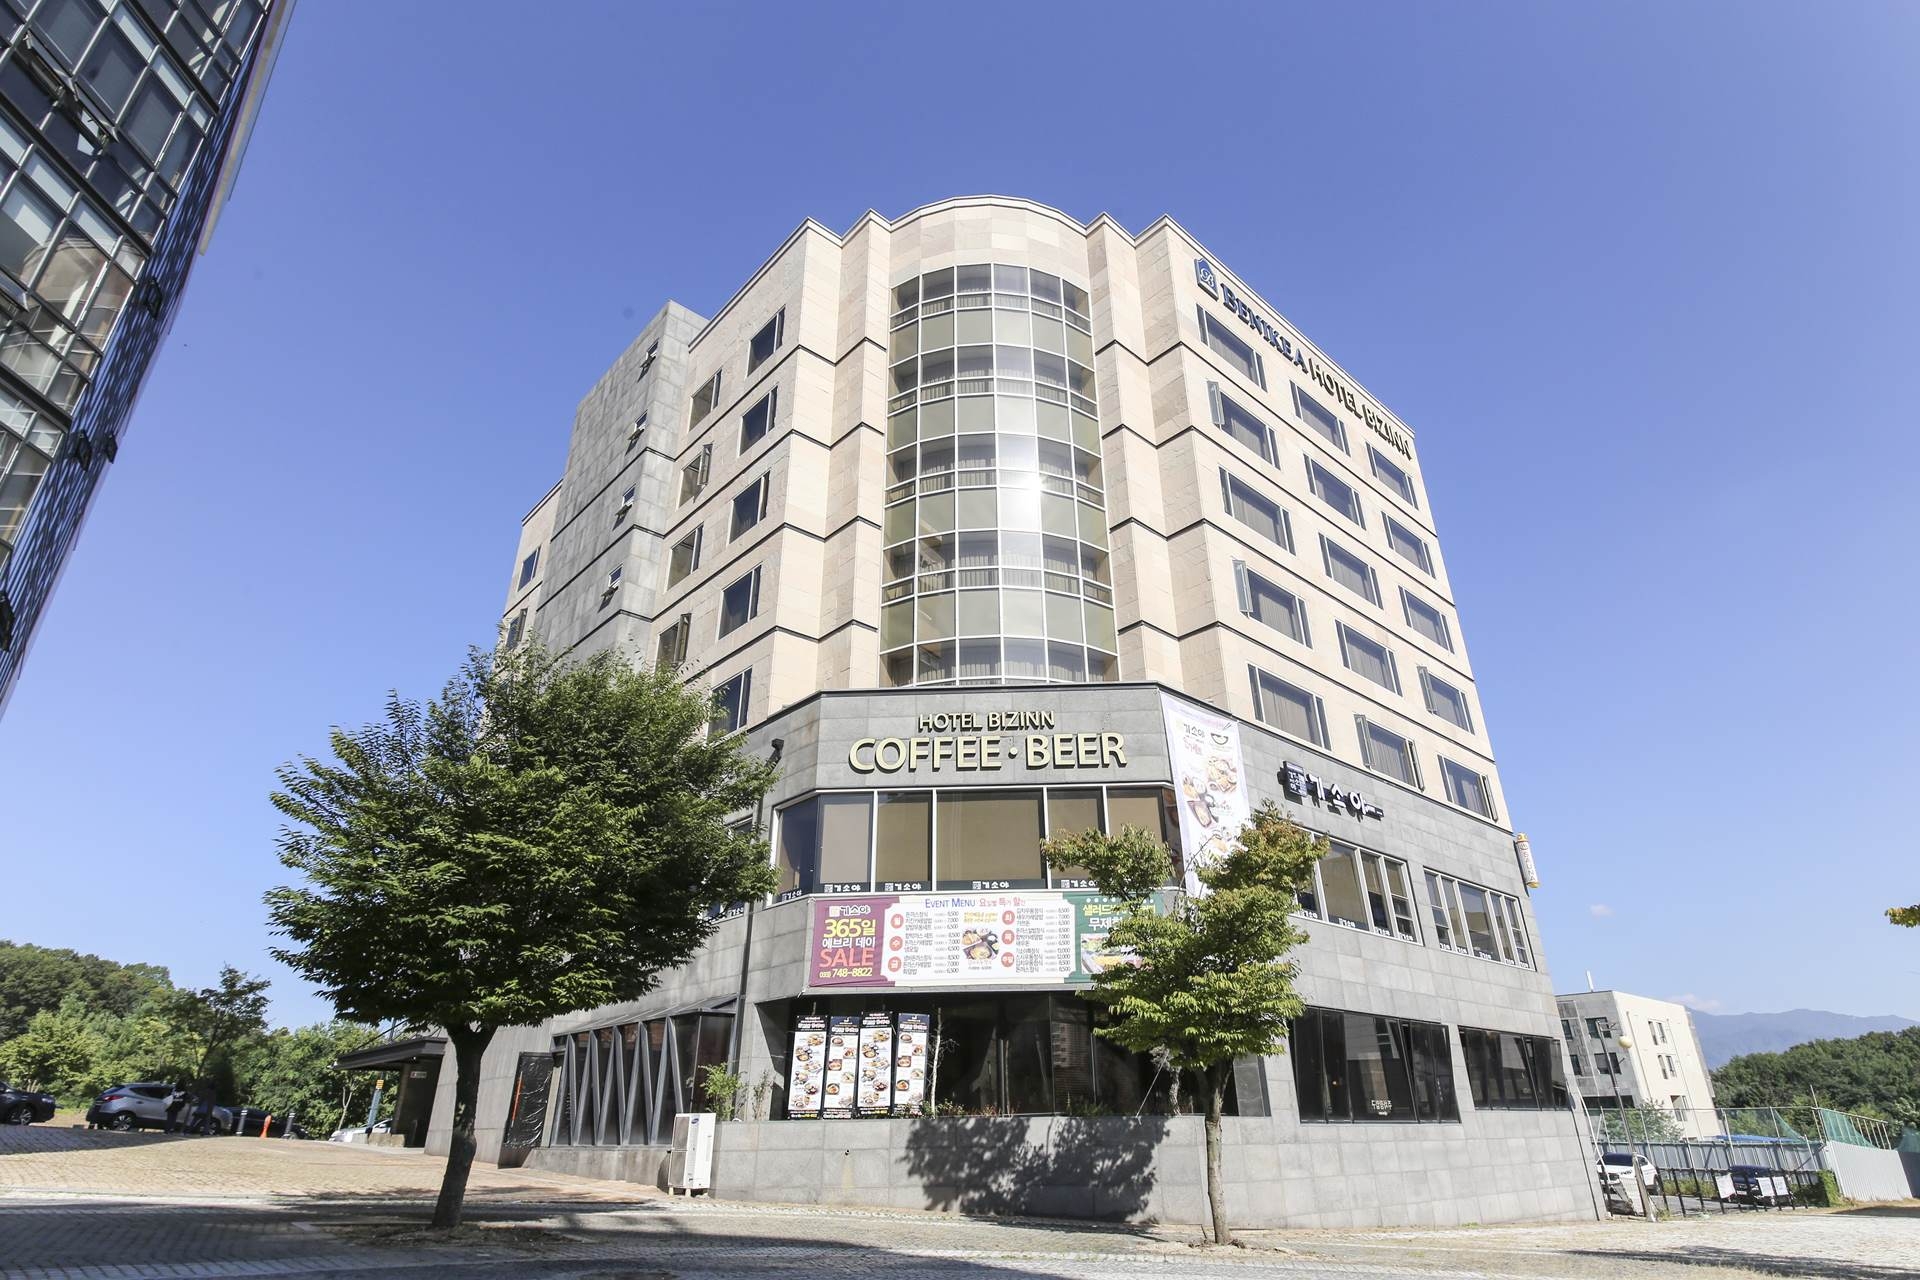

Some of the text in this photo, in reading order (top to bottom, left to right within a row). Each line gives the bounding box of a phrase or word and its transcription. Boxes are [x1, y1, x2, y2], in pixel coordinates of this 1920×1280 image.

[1220, 283, 1412, 461] BENIKEA HOTEL BIZINN
[918, 710, 1055, 732] HOTEL BIZINN
[848, 731, 1127, 774] COFFEE BEER
[1306, 773, 1367, 815] 기소야
[925, 898, 950, 908] EVENT
[951, 898, 976, 907] MENU
[823, 918, 876, 938] 365일
[822, 937, 876, 949] 에브리 데이
[819, 948, 875, 968] SALE
[832, 968, 873, 978] 748-8822
